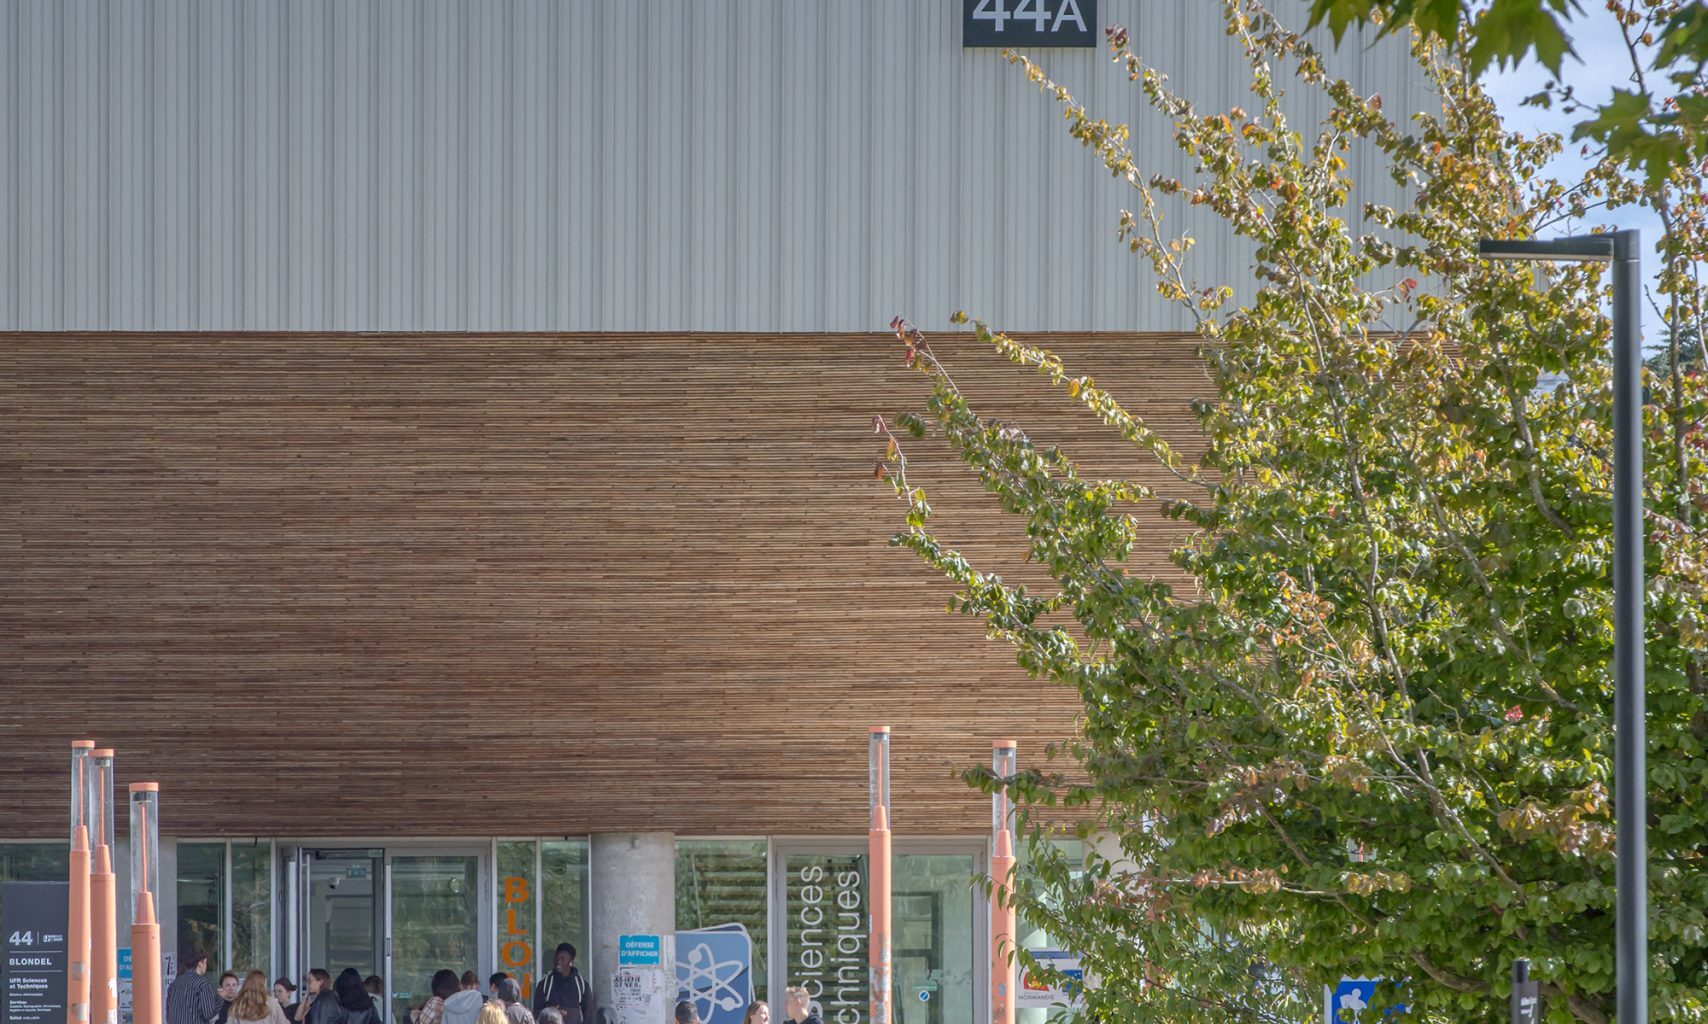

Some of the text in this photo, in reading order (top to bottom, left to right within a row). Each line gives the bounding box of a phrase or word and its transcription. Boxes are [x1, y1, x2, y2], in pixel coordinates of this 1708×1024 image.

[972, 0, 1088, 32] 44A
[9, 930, 33, 946] 44
[9, 957, 52, 966] BLONDEL
